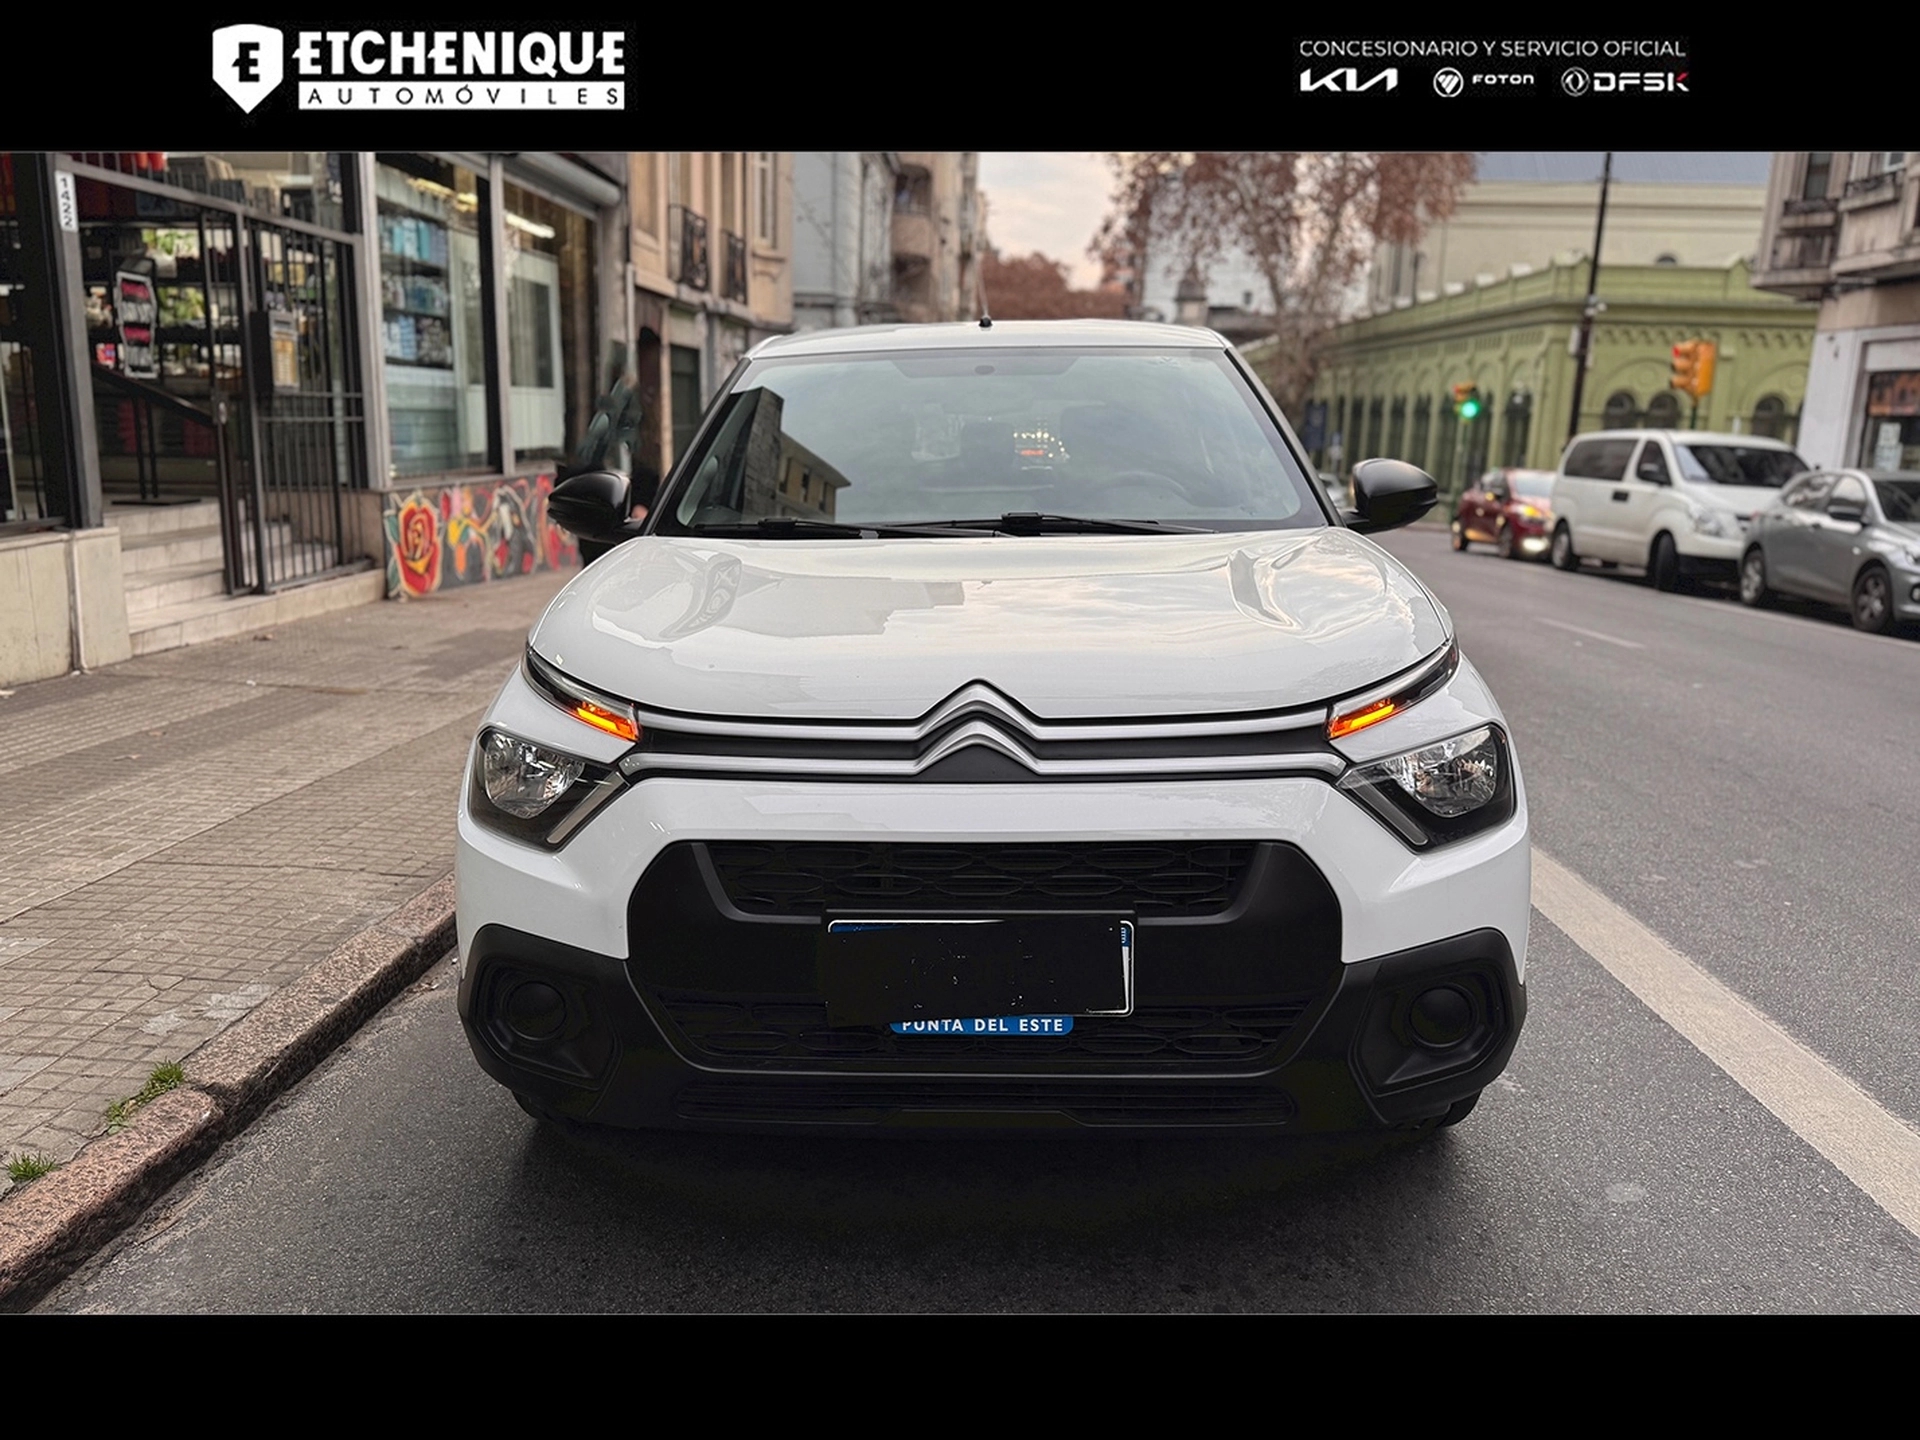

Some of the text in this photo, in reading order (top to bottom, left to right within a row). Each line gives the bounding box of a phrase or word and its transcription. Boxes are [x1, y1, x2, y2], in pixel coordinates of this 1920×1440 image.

[60, 177, 73, 228] 1422
[902, 1018, 1063, 1032] PUNTA DEL ESTE
